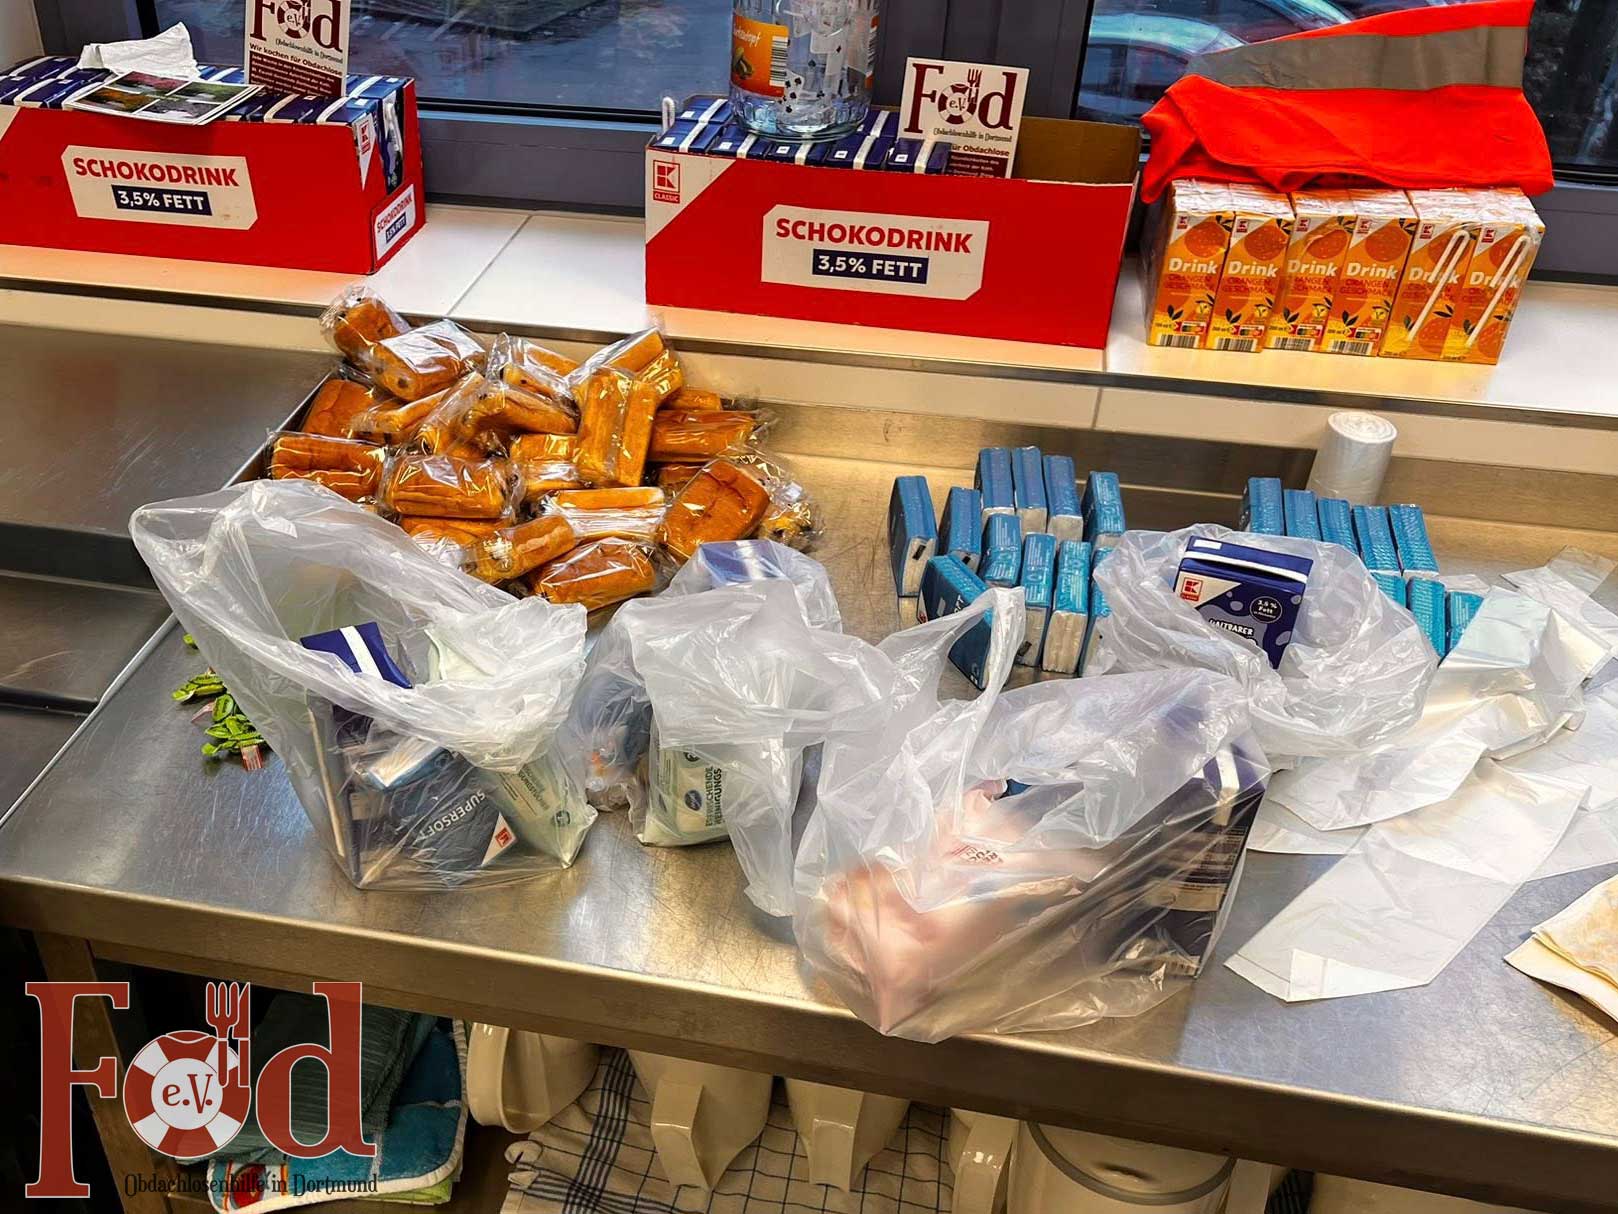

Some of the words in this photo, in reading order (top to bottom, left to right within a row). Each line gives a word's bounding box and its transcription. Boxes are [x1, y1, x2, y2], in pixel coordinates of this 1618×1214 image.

[249, 42, 262, 52] Wir
[263, 46, 289, 60] kochen
[290, 54, 302, 64] für
[302, 59, 344, 76] Obdachlose
[949, 97, 966, 110] e.V.
[963, 145, 1010, 157] Obdachlose
[73, 157, 240, 188] SCHOKODRINK
[118, 190, 160, 210] 3,5%
[163, 193, 206, 212] FETT
[654, 192, 679, 202] CLASSIC
[775, 217, 975, 254] SCHOKODRINK
[817, 255, 867, 275] 3,5%
[871, 259, 923, 280] FETT
[1168, 258, 1219, 274] Drink
[1227, 261, 1279, 278] Drink
[1287, 259, 1338, 276] Drink
[1346, 262, 1398, 279] Drink
[1409, 267, 1461, 284] Drk
[416, 790, 487, 841] SUPERSOFT
